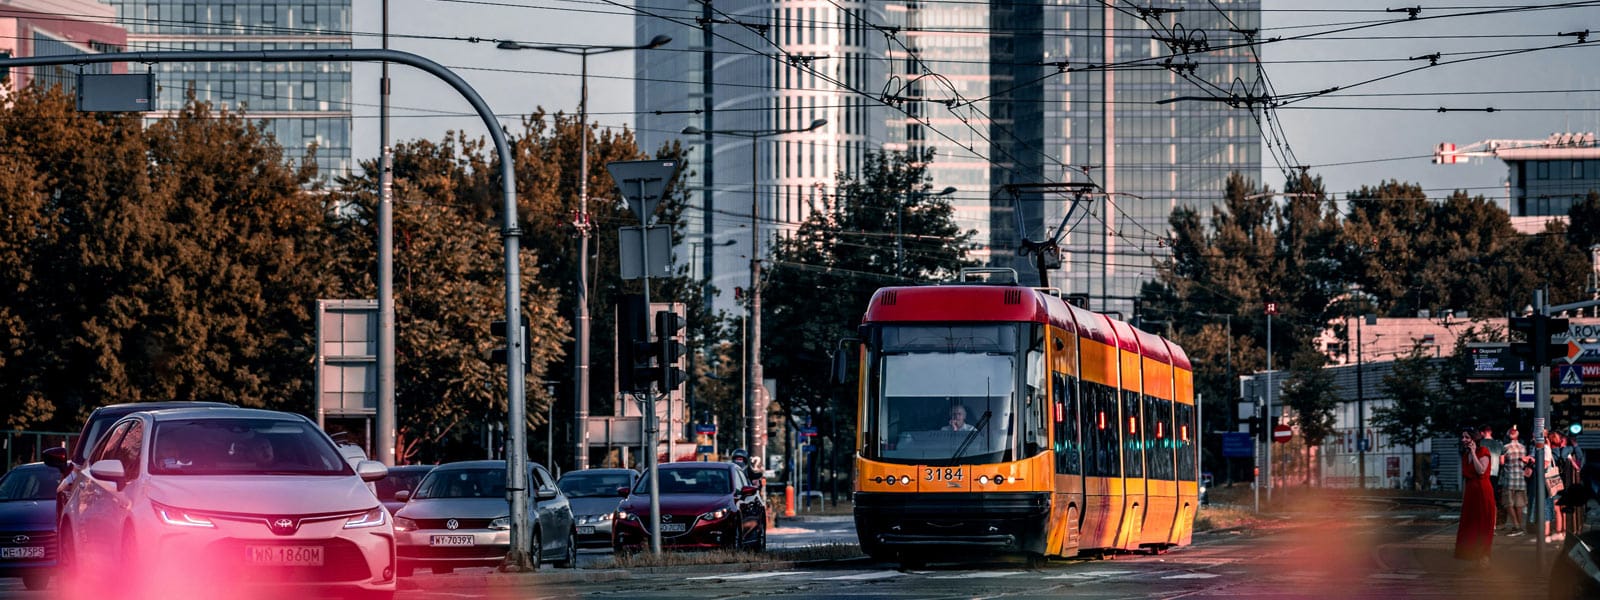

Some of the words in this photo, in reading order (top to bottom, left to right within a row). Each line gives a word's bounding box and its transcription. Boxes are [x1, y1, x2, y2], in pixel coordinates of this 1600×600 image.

[925, 467, 963, 481] 3184
[435, 536, 445, 545] WY
[447, 536, 472, 545] 7039X
[256, 547, 273, 562] WN
[280, 547, 320, 562] 1860M
